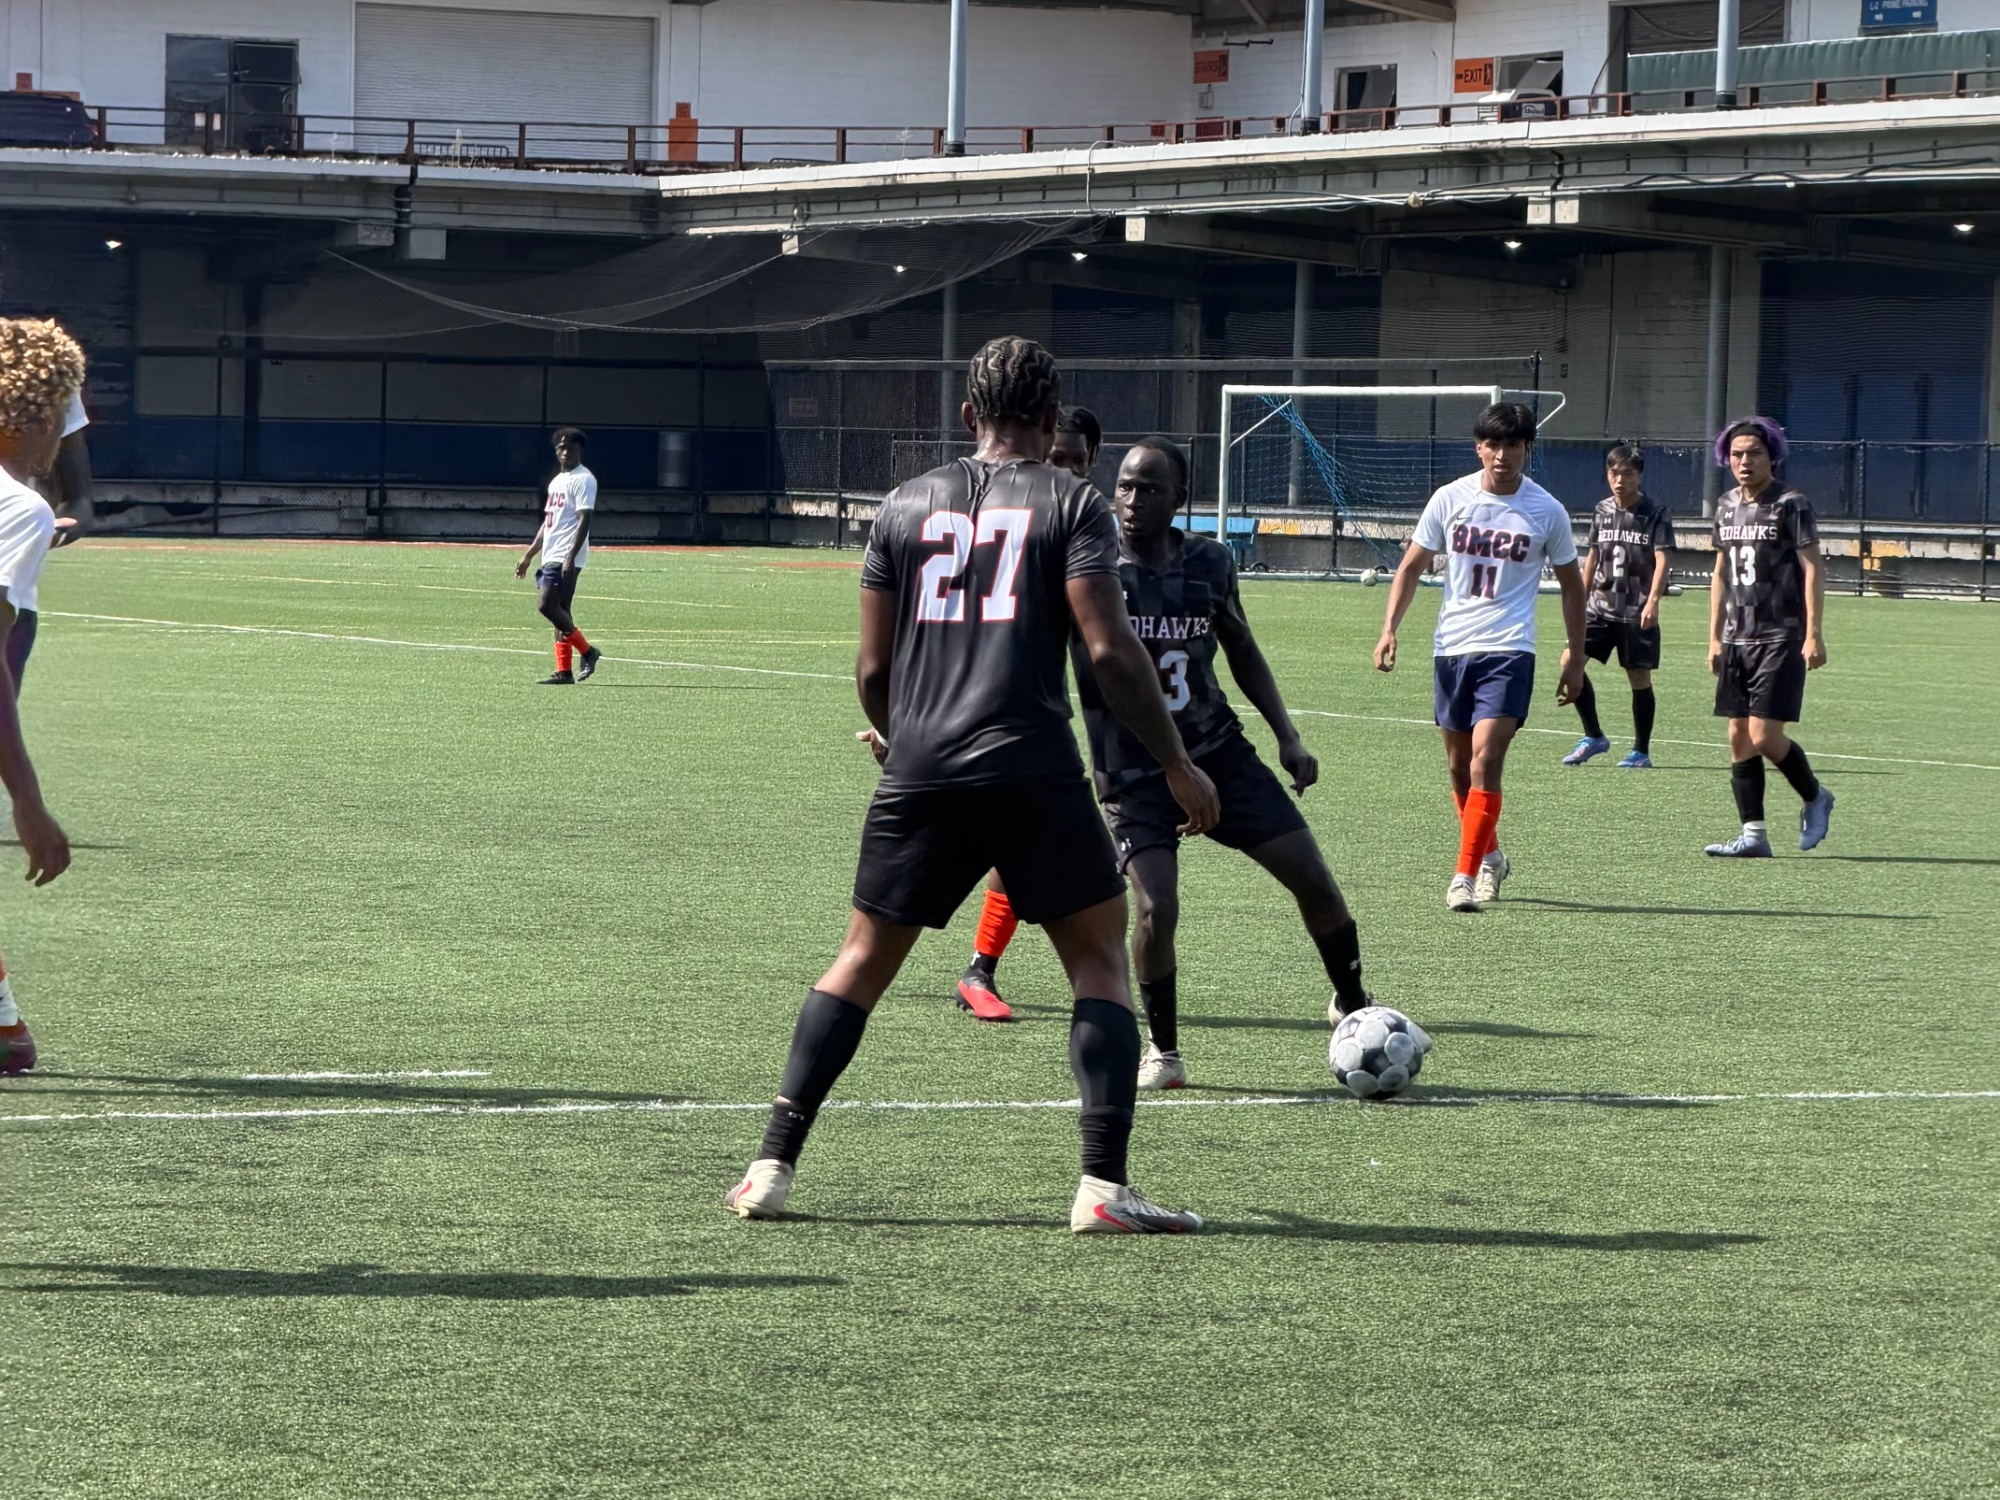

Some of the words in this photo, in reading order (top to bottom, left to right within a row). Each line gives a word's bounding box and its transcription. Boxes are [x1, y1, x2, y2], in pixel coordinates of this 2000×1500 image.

[1463, 68, 1483, 84] EXIT
[547, 491, 565, 508] CC
[1452, 524, 1531, 562] BMCC
[1719, 525, 1778, 541] EDHAWKS
[917, 508, 1034, 623] 27
[1612, 545, 1626, 577] 2
[1729, 546, 1756, 586] 13
[1471, 563, 1498, 600] 11
[1129, 616, 1210, 639] DHAWKS
[1160, 650, 1191, 711] 3
